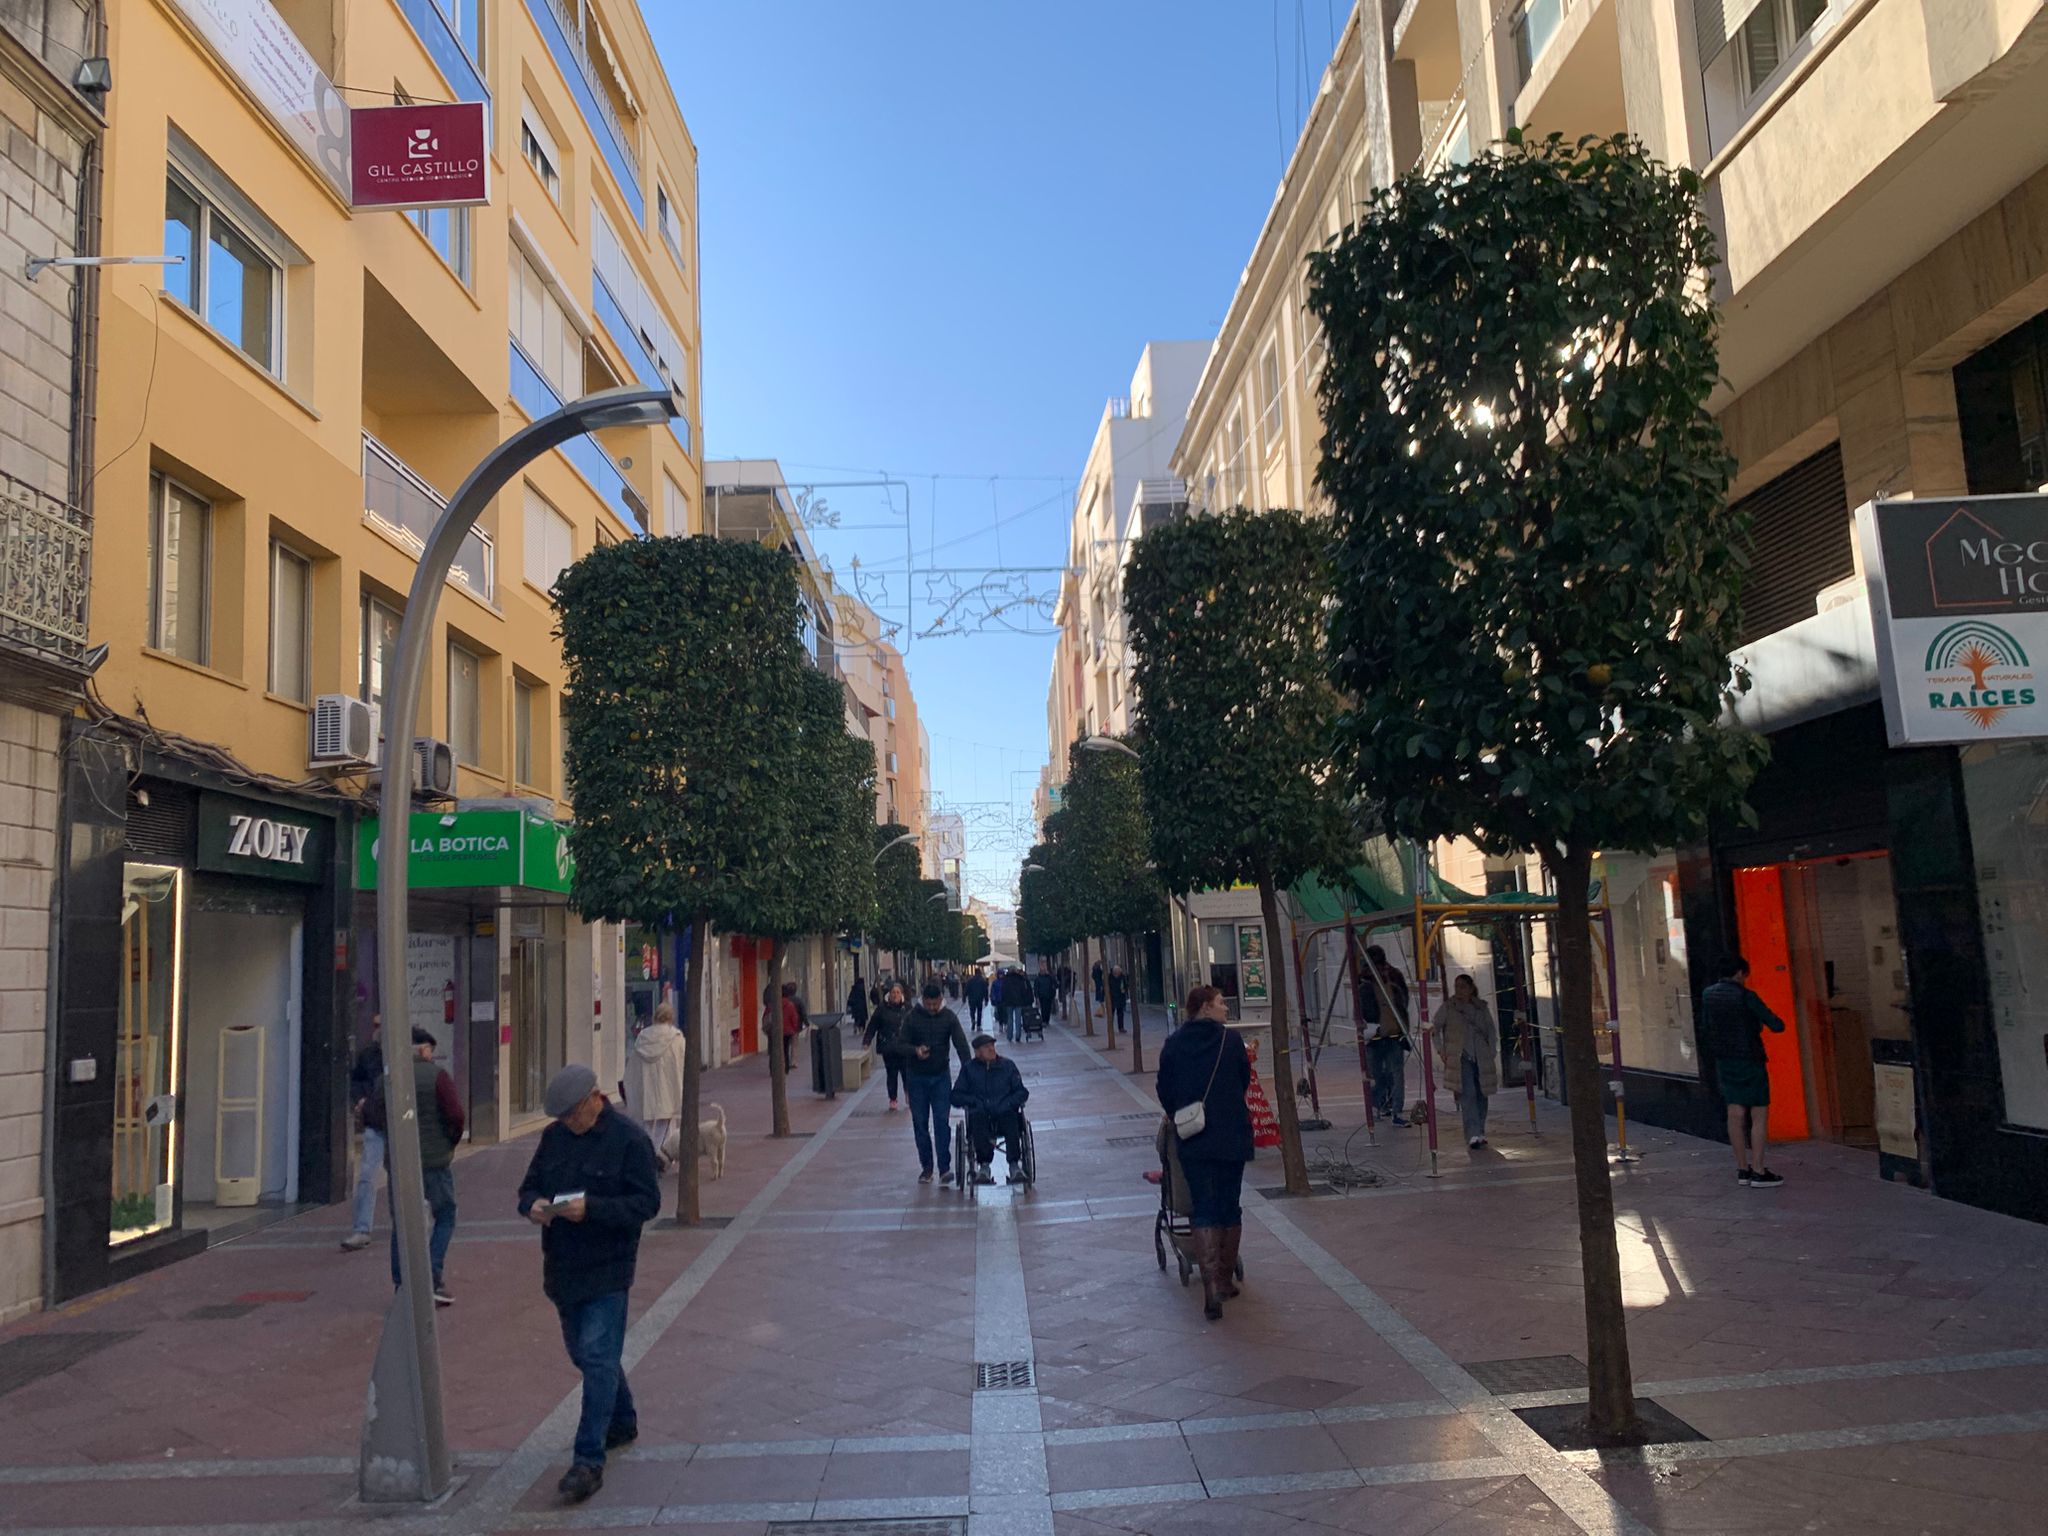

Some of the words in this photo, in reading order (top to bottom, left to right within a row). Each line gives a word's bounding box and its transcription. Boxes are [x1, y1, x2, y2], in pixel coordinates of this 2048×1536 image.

[368, 165, 395, 177] GIL
[400, 159, 479, 175] CASTILLO
[1926, 676, 1973, 684] TERAPIAS
[1983, 672, 2034, 682] NATURALES
[1928, 684, 2036, 709] RAÍCES
[227, 815, 311, 864] ZOEY
[410, 838, 434, 853] LA
[439, 836, 510, 852] BOTICA
[408, 936, 450, 948] idarse
